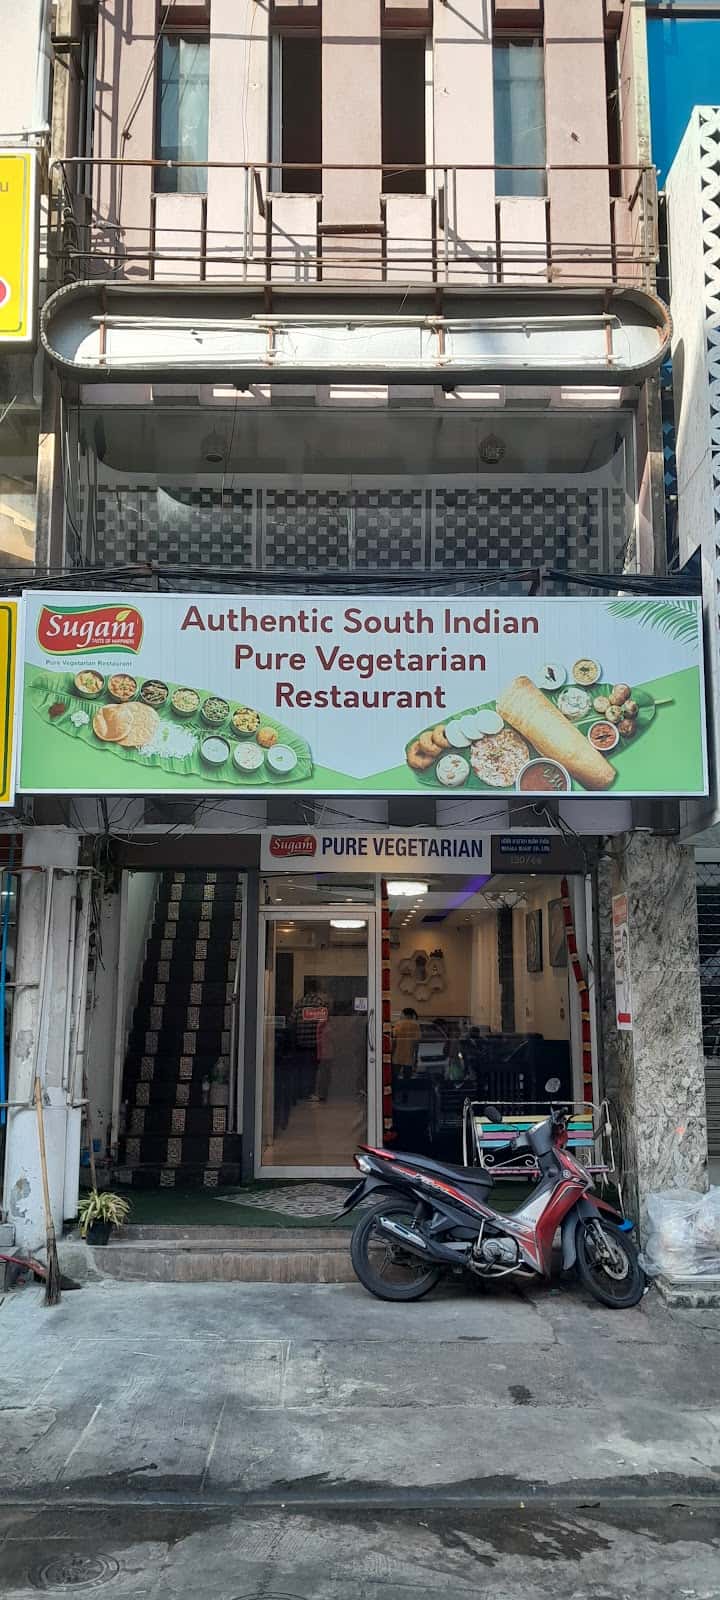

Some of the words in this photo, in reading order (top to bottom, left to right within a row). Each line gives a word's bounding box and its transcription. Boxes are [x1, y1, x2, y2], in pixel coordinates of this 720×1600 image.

[46, 614, 135, 648] Sugam
[181, 605, 333, 633] Authentic
[344, 608, 434, 633] South
[445, 608, 539, 633] Indian
[62, 659, 96, 667] Vegetarian
[234, 644, 306, 670] Pure
[315, 645, 486, 678] Vegetarian
[275, 682, 446, 708] Restaurant
[272, 838, 313, 853] Sugam
[322, 836, 368, 856] PURE
[372, 837, 483, 858] VEGETARIAN
